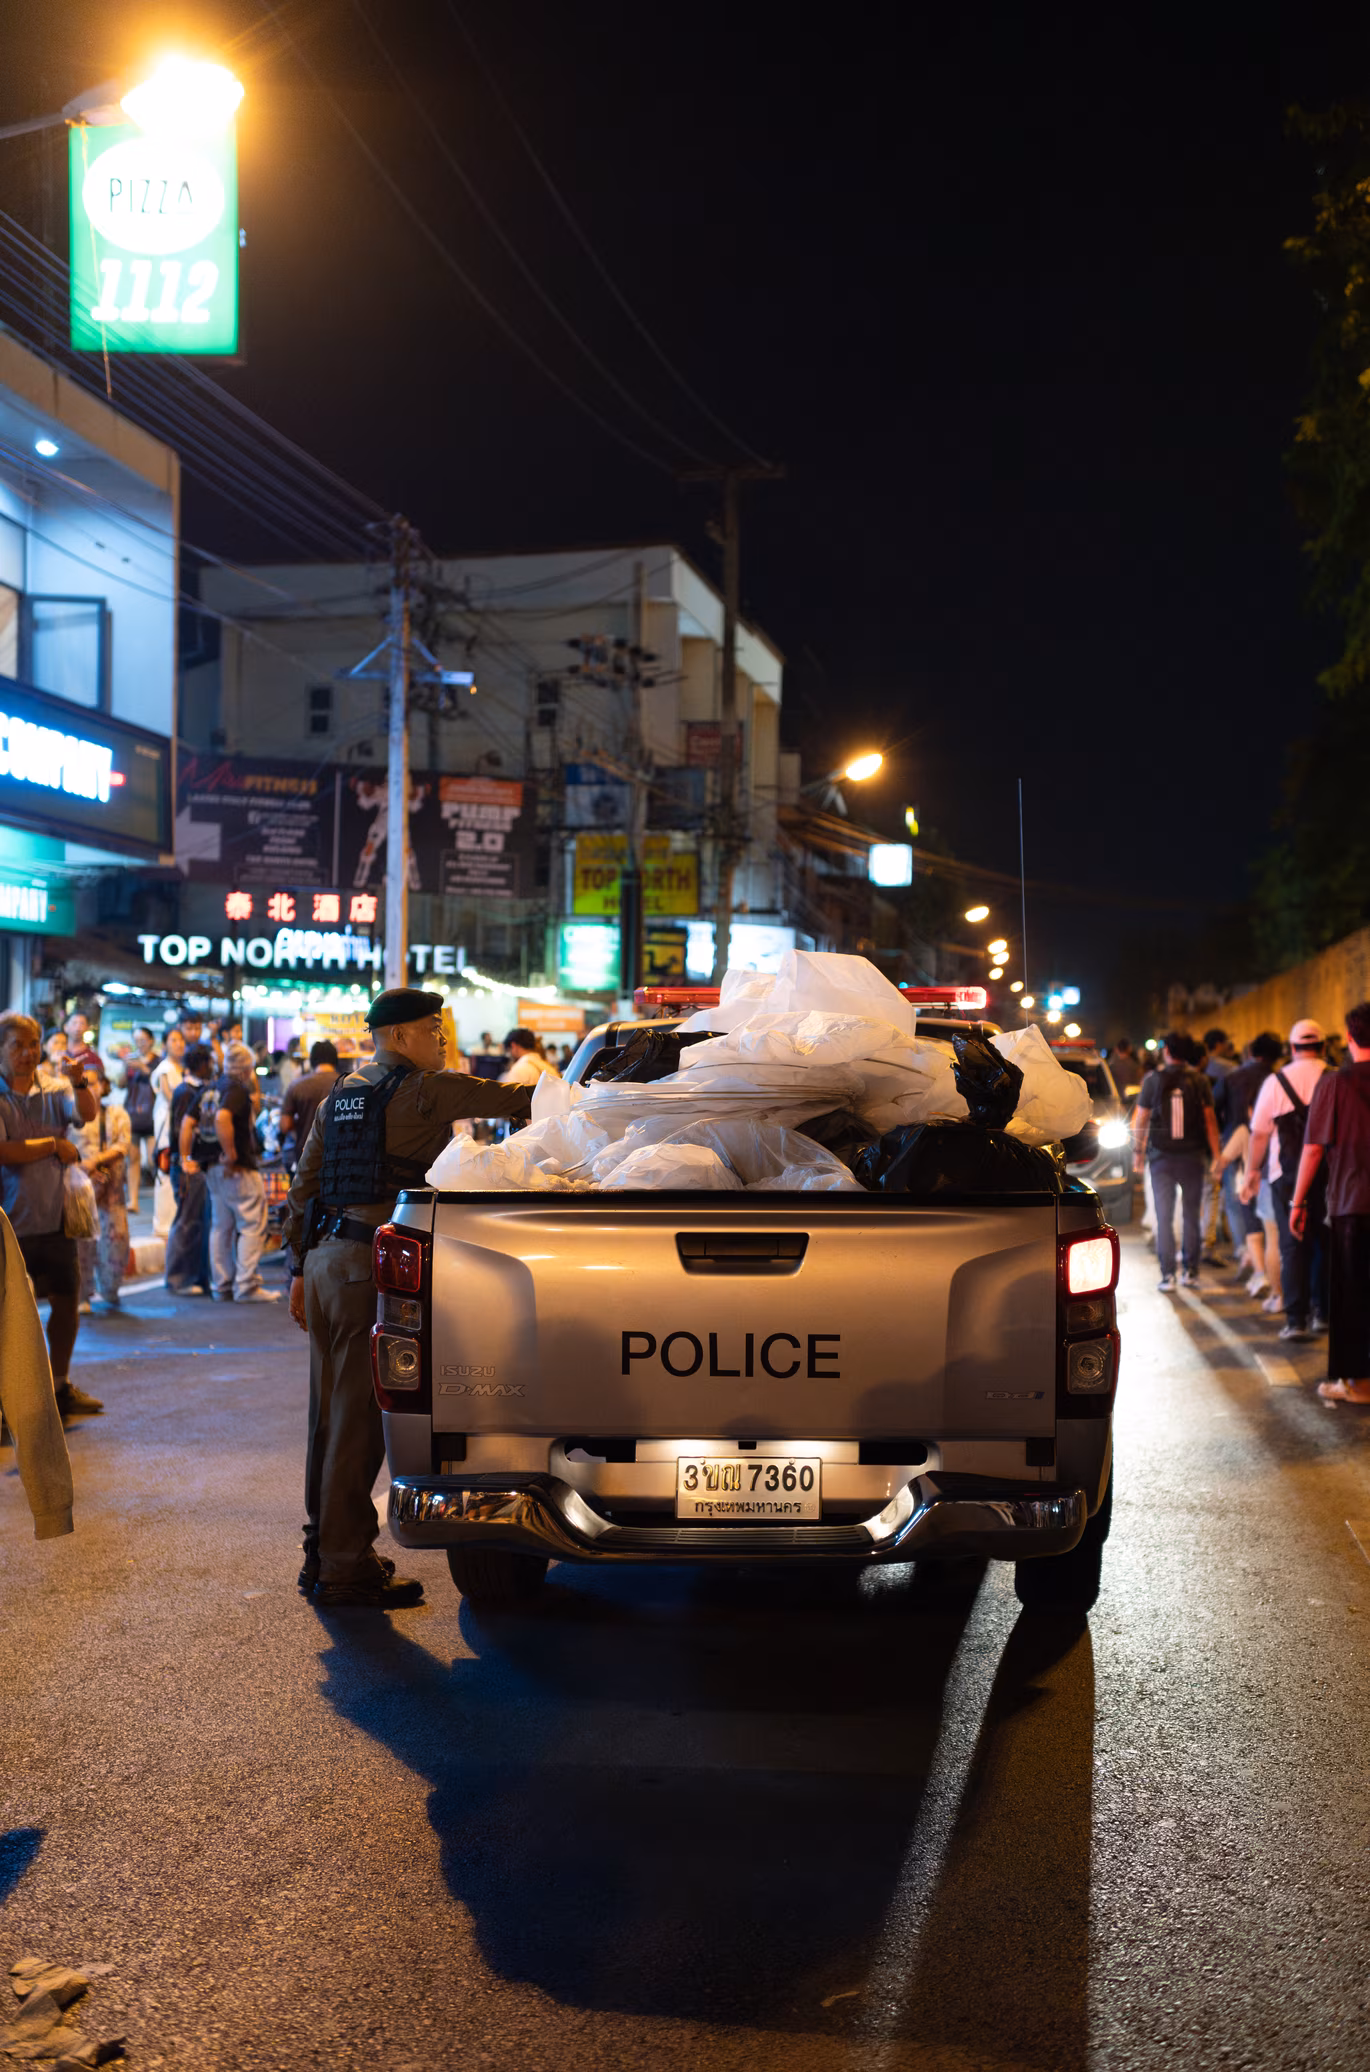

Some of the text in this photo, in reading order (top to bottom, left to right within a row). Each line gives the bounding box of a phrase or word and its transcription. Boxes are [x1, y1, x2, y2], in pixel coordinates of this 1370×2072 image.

[109, 177, 194, 214] PIZZA
[91, 259, 219, 322] 1112
[581, 867, 691, 892] TOP ORTH
[603, 895, 663, 911] HEL
[138, 934, 212, 966] TOP
[357, 943, 468, 976] HTEL
[334, 1096, 365, 1112] POLICE
[621, 1330, 841, 1379] POLICE
[440, 1365, 496, 1378] ISUZU
[747, 1464, 814, 1492] 7360
[695, 1501, 802, 1516] กรุงเทพมหานคร
